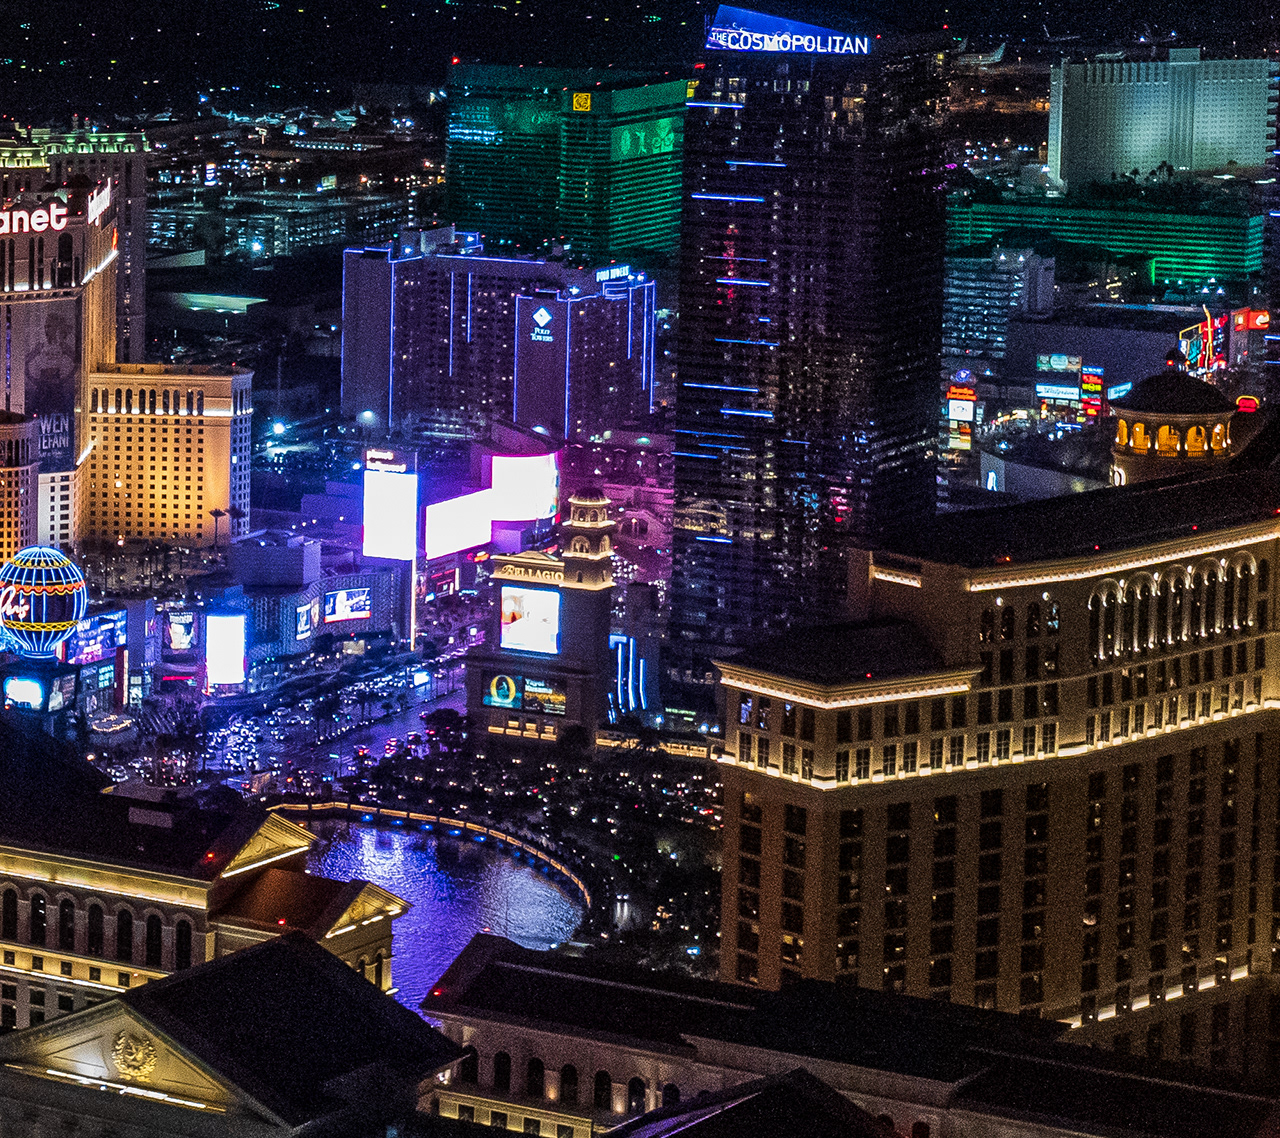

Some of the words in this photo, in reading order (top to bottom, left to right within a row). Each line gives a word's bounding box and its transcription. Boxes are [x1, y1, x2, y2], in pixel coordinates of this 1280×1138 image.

[712, 32, 727, 41] THE
[727, 33, 869, 54] COSMOPOLITAN
[40, 414, 69, 434] WEN
[38, 434, 69, 449] TEFANI
[501, 564, 564, 581] BELLAGIO
